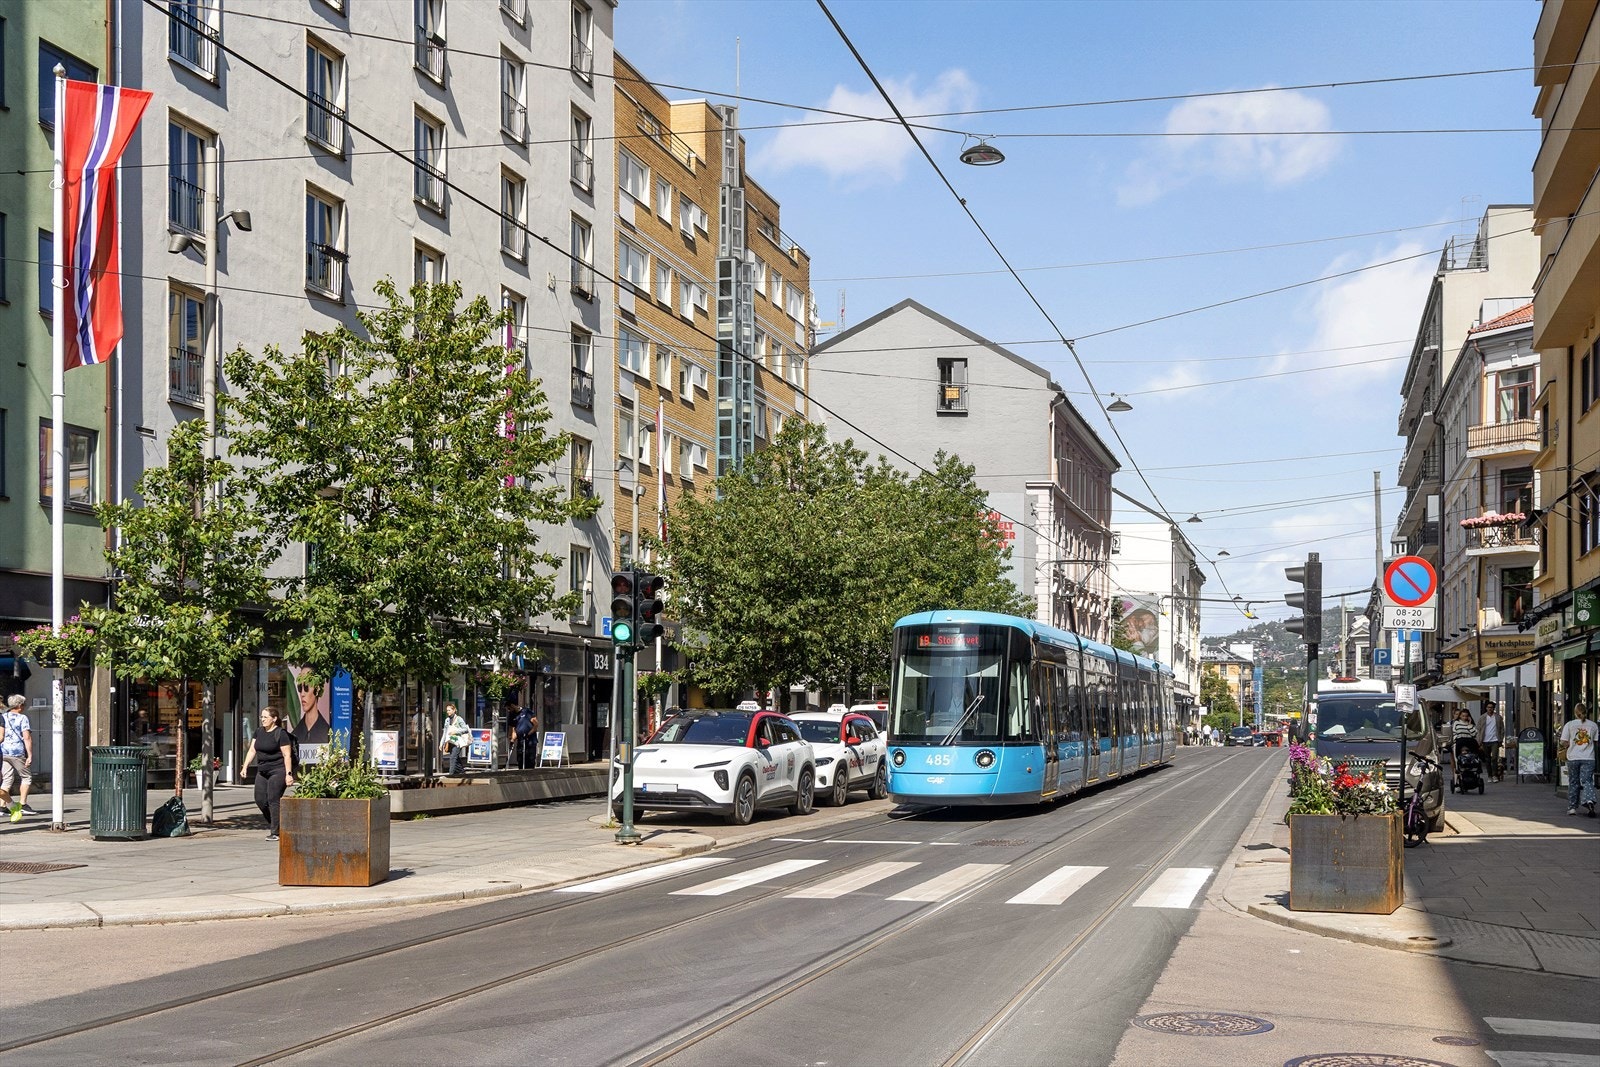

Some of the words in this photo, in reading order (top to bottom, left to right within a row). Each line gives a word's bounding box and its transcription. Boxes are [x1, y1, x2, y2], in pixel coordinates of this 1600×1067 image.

[919, 635, 930, 646] 19
[1485, 639, 1535, 648] Markedsplasse
[594, 653, 609, 670] B34
[1378, 651, 1388, 664] P
[925, 754, 951, 766] 485
